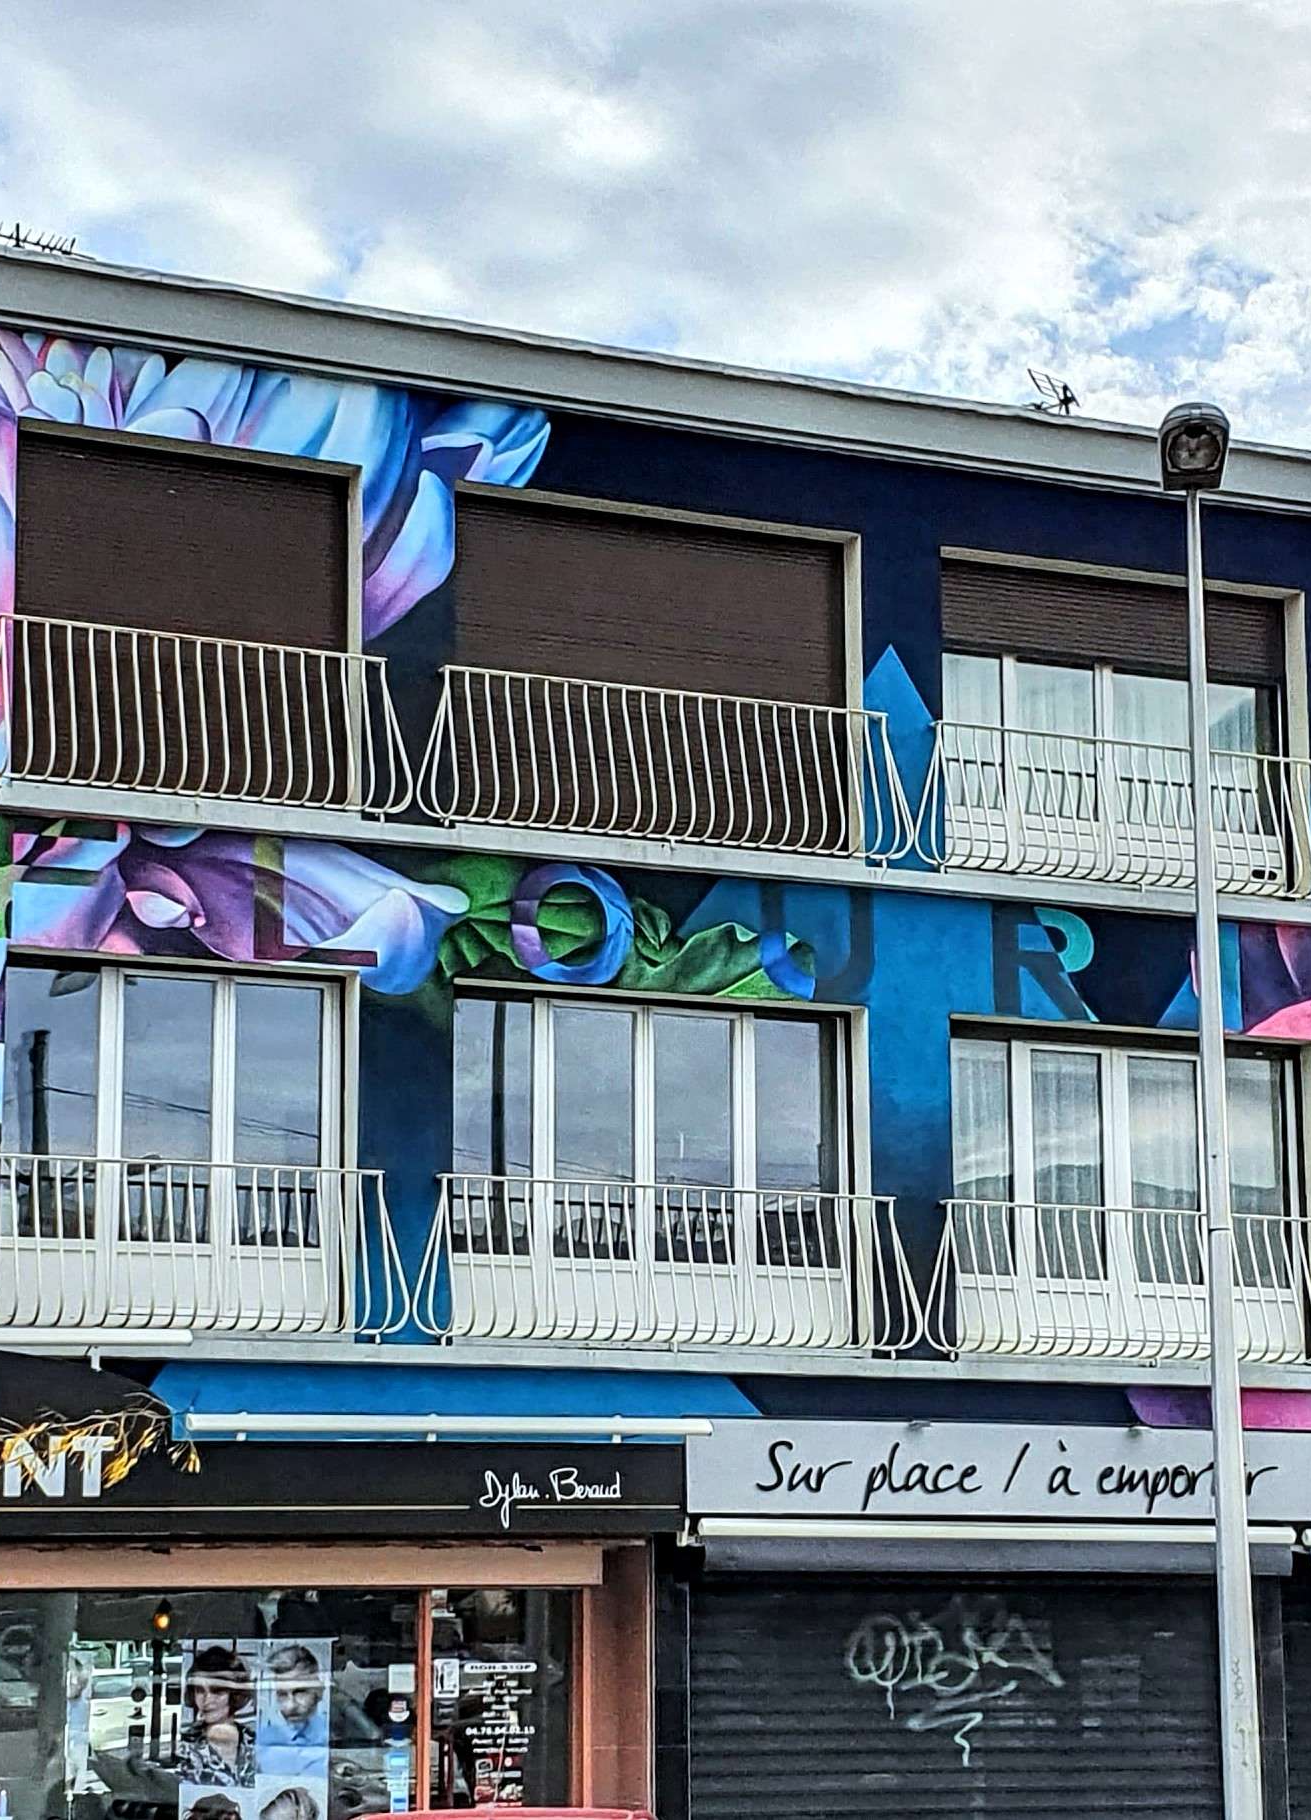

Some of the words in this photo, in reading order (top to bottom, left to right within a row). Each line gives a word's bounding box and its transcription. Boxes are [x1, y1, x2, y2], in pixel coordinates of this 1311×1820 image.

[755, 1440, 853, 1492] Sur
[861, 1441, 983, 1512] place
[1047, 1438, 1082, 1496] à
[1097, 1461, 1279, 1515] emporr
